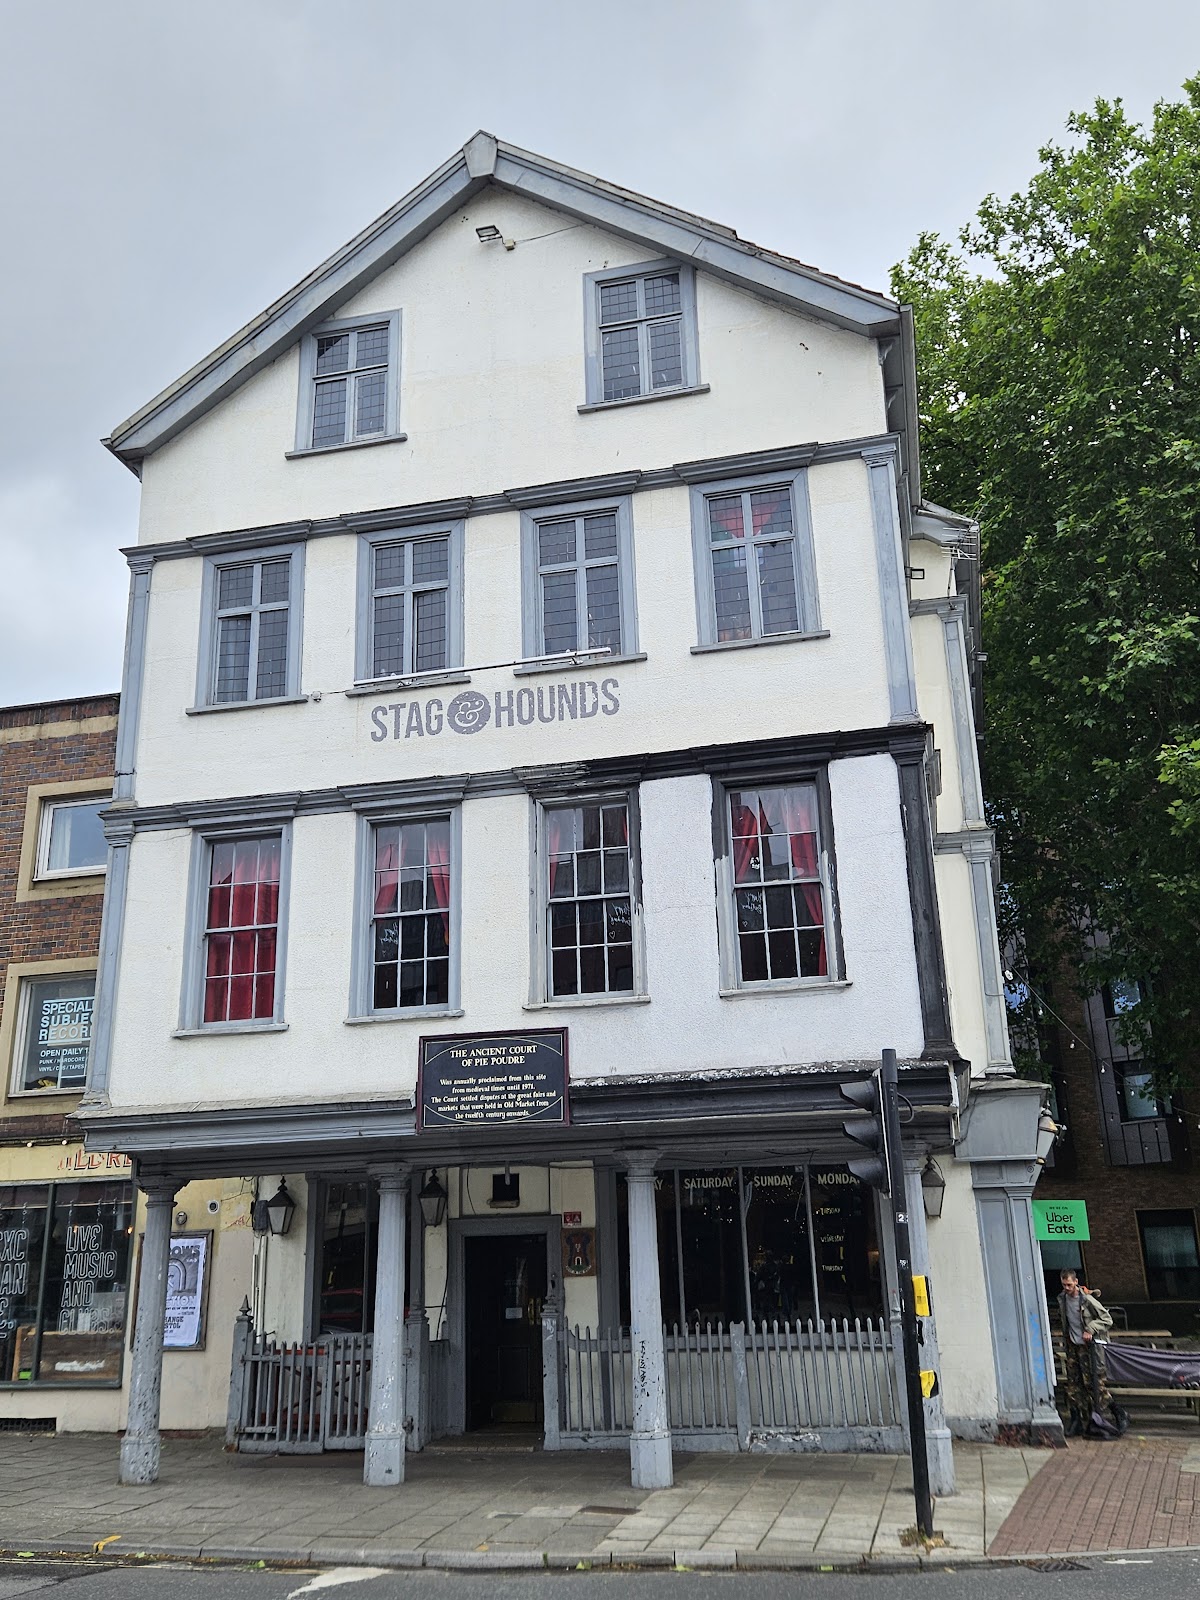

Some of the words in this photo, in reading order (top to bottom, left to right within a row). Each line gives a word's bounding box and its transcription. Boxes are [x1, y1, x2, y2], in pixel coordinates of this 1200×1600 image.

[371, 698, 444, 742] STAG
[450, 695, 488, 730] &
[495, 678, 620, 728] HOUNDS
[42, 1000, 95, 1015] SPECIAL
[39, 1025, 92, 1040] RECOR
[40, 1049, 61, 1057] OPEN
[62, 1047, 83, 1055] DAILY
[450, 1050, 467, 1058] THE
[470, 1047, 507, 1057] ANCIENT
[509, 1045, 538, 1054] COURT
[461, 1059, 473, 1067] OF
[474, 1058, 488, 1066] PIE
[491, 1056, 525, 1065] POUDRE
[453, 1077, 476, 1085] annually
[478, 1075, 507, 1084] proclaimed
[509, 1074, 522, 1082] from
[452, 1086, 465, 1094] from
[466, 1085, 490, 1093] medieval
[490, 1084, 506, 1092] times
[506, 1083, 520, 1091] until
[460, 1094, 478, 1102] settled
[480, 1093, 501, 1102] disputes
[517, 1091, 532, 1102] great
[533, 1090, 546, 1098] fairs
[546, 1089, 557, 1097] and
[438, 1104, 458, 1112] markets
[460, 1103, 470, 1111] that
[485, 1102, 496, 1110] held
[504, 1100, 514, 1108] Old
[515, 1100, 535, 1108] Market
[465, 1111, 484, 1119] twelfth
[486, 1110, 506, 1119] century
[684, 1176, 734, 1191] SATURDAY
[754, 1174, 794, 1187] SUNDAY
[817, 1172, 860, 1185] MONDA
[1046, 1211, 1073, 1222] Uber
[1047, 1223, 1075, 1233] Eats
[66, 1225, 101, 1252] LIVE
[63, 1251, 116, 1279] MUSIC
[61, 1280, 94, 1307] AND
